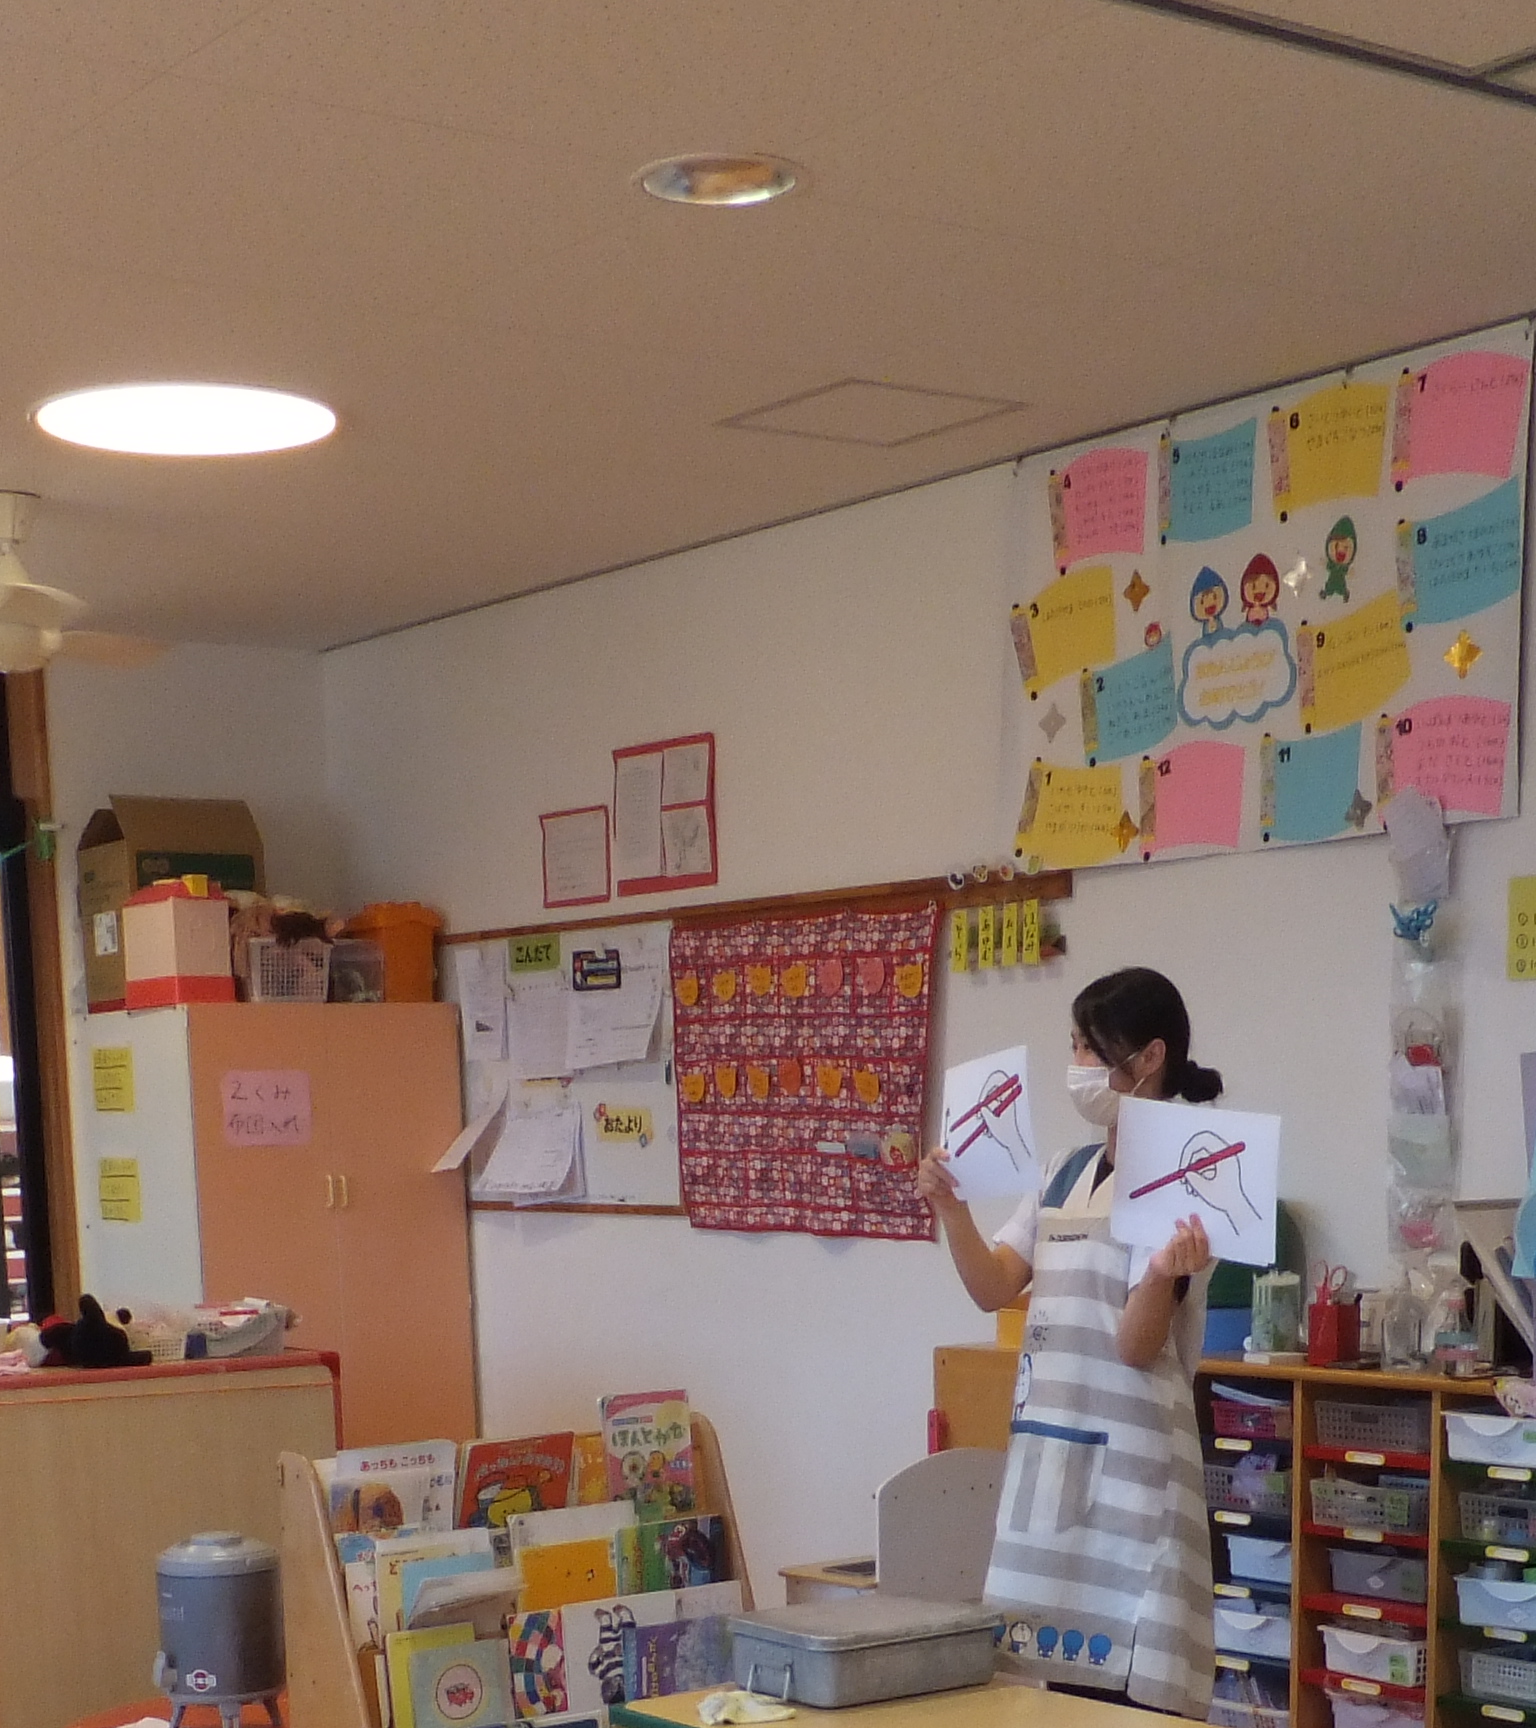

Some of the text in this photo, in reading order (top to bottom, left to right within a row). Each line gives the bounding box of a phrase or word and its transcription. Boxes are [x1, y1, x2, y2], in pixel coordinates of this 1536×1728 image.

[1417, 373, 1428, 393] 7
[1289, 412, 1300, 430] 6
[1029, 602, 1039, 618] 3
[1316, 631, 1325, 649] 9
[1095, 676, 1105, 693] 2
[1395, 718, 1413, 737] 10
[1278, 746, 1291, 763] 11
[1157, 759, 1172, 777] 12
[1045, 771, 1052, 786] 1
[515, 943, 552, 964] こんだて
[604, 1115, 642, 1134] おたより
[360, 1453, 435, 1472] あっちも こっちも
